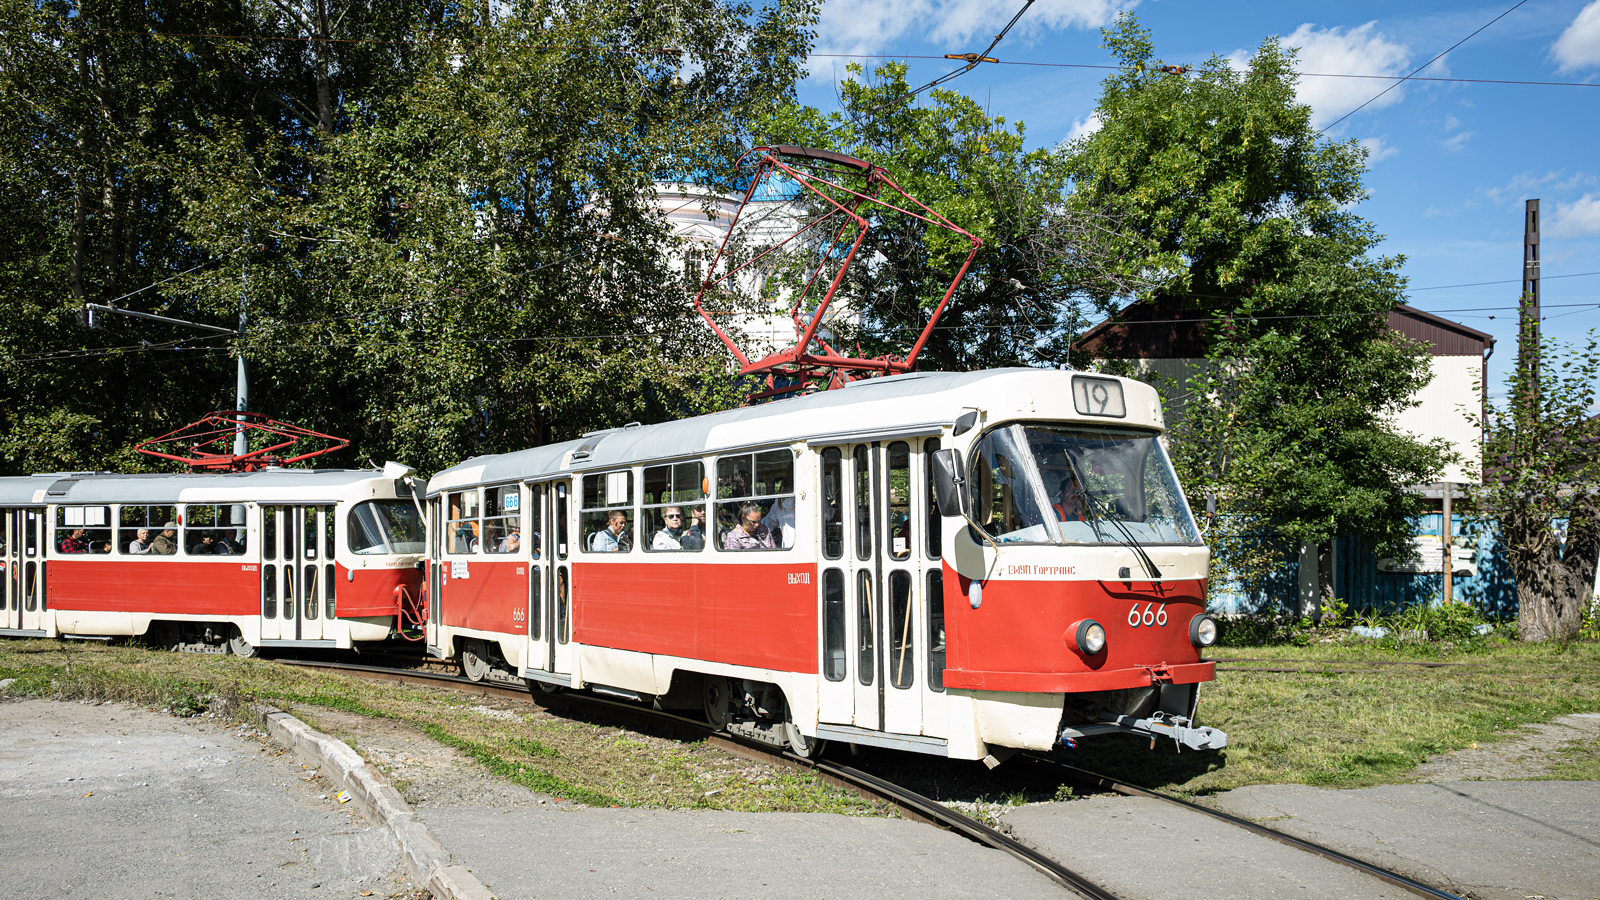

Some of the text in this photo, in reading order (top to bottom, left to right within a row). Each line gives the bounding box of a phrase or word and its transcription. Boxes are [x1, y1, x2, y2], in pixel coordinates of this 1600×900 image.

[1082, 382, 1108, 414] 19
[505, 495, 518, 508] 666
[787, 572, 811, 584] ВЫХОД
[513, 607, 525, 622] 666
[1127, 602, 1169, 628] 666
